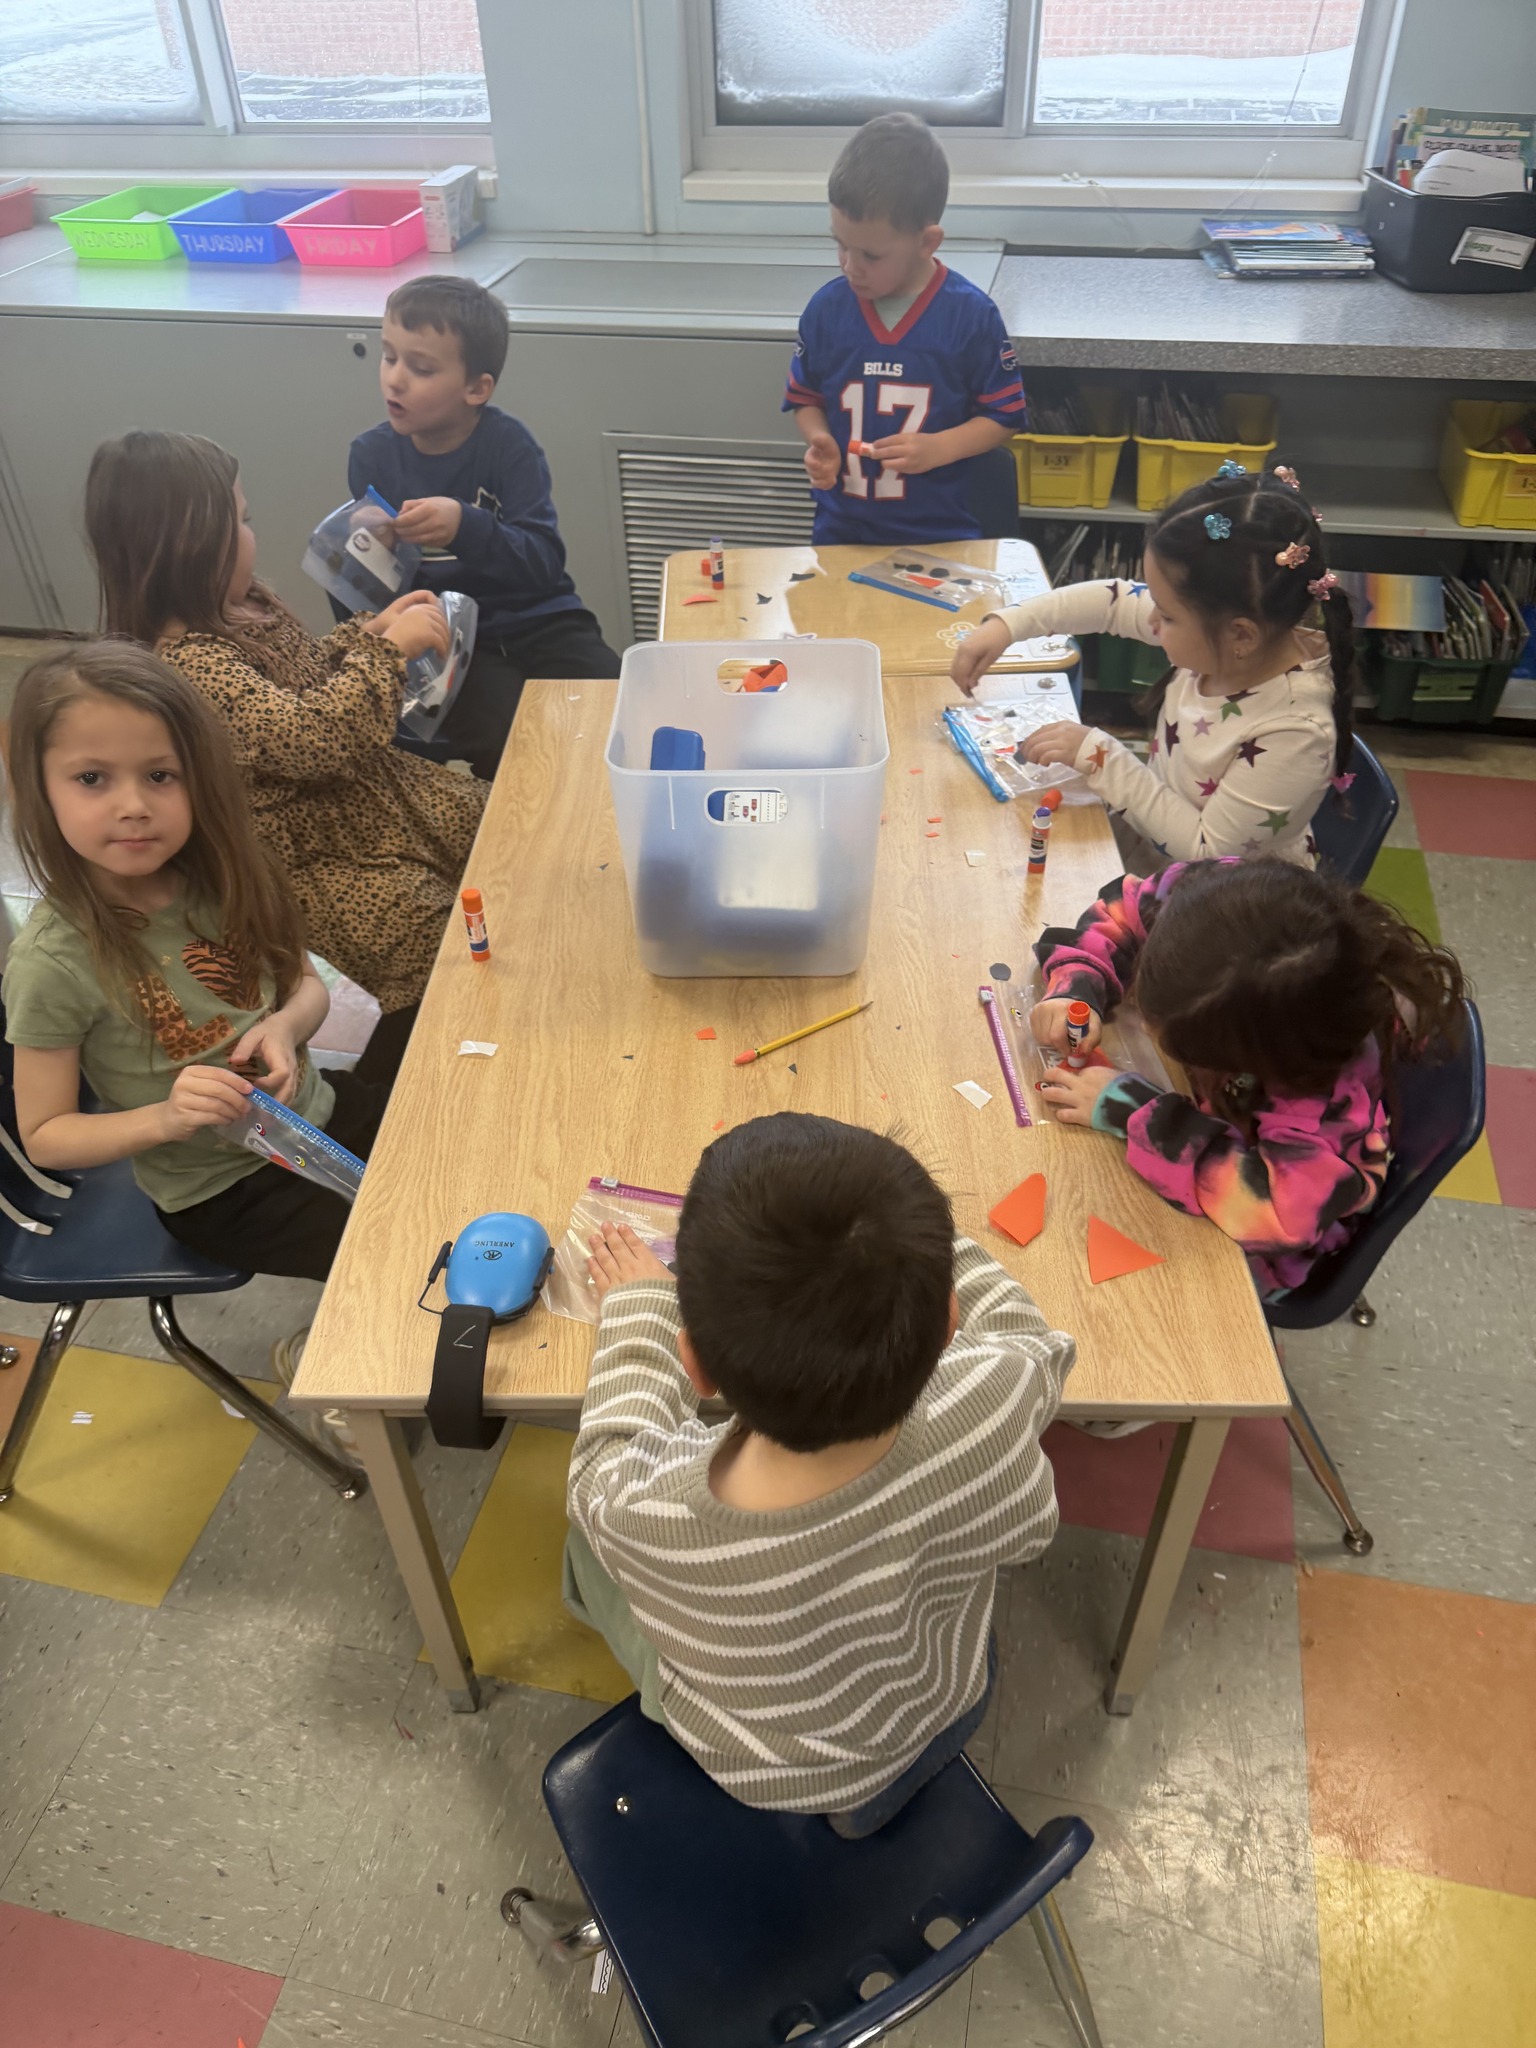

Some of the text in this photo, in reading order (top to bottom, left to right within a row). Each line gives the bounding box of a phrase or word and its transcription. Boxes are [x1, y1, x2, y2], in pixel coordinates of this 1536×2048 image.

[181, 233, 265, 254] THURSDAY
[303, 234, 378, 257] FRIDAY
[863, 361, 904, 377] BILLS
[839, 380, 933, 501] 17
